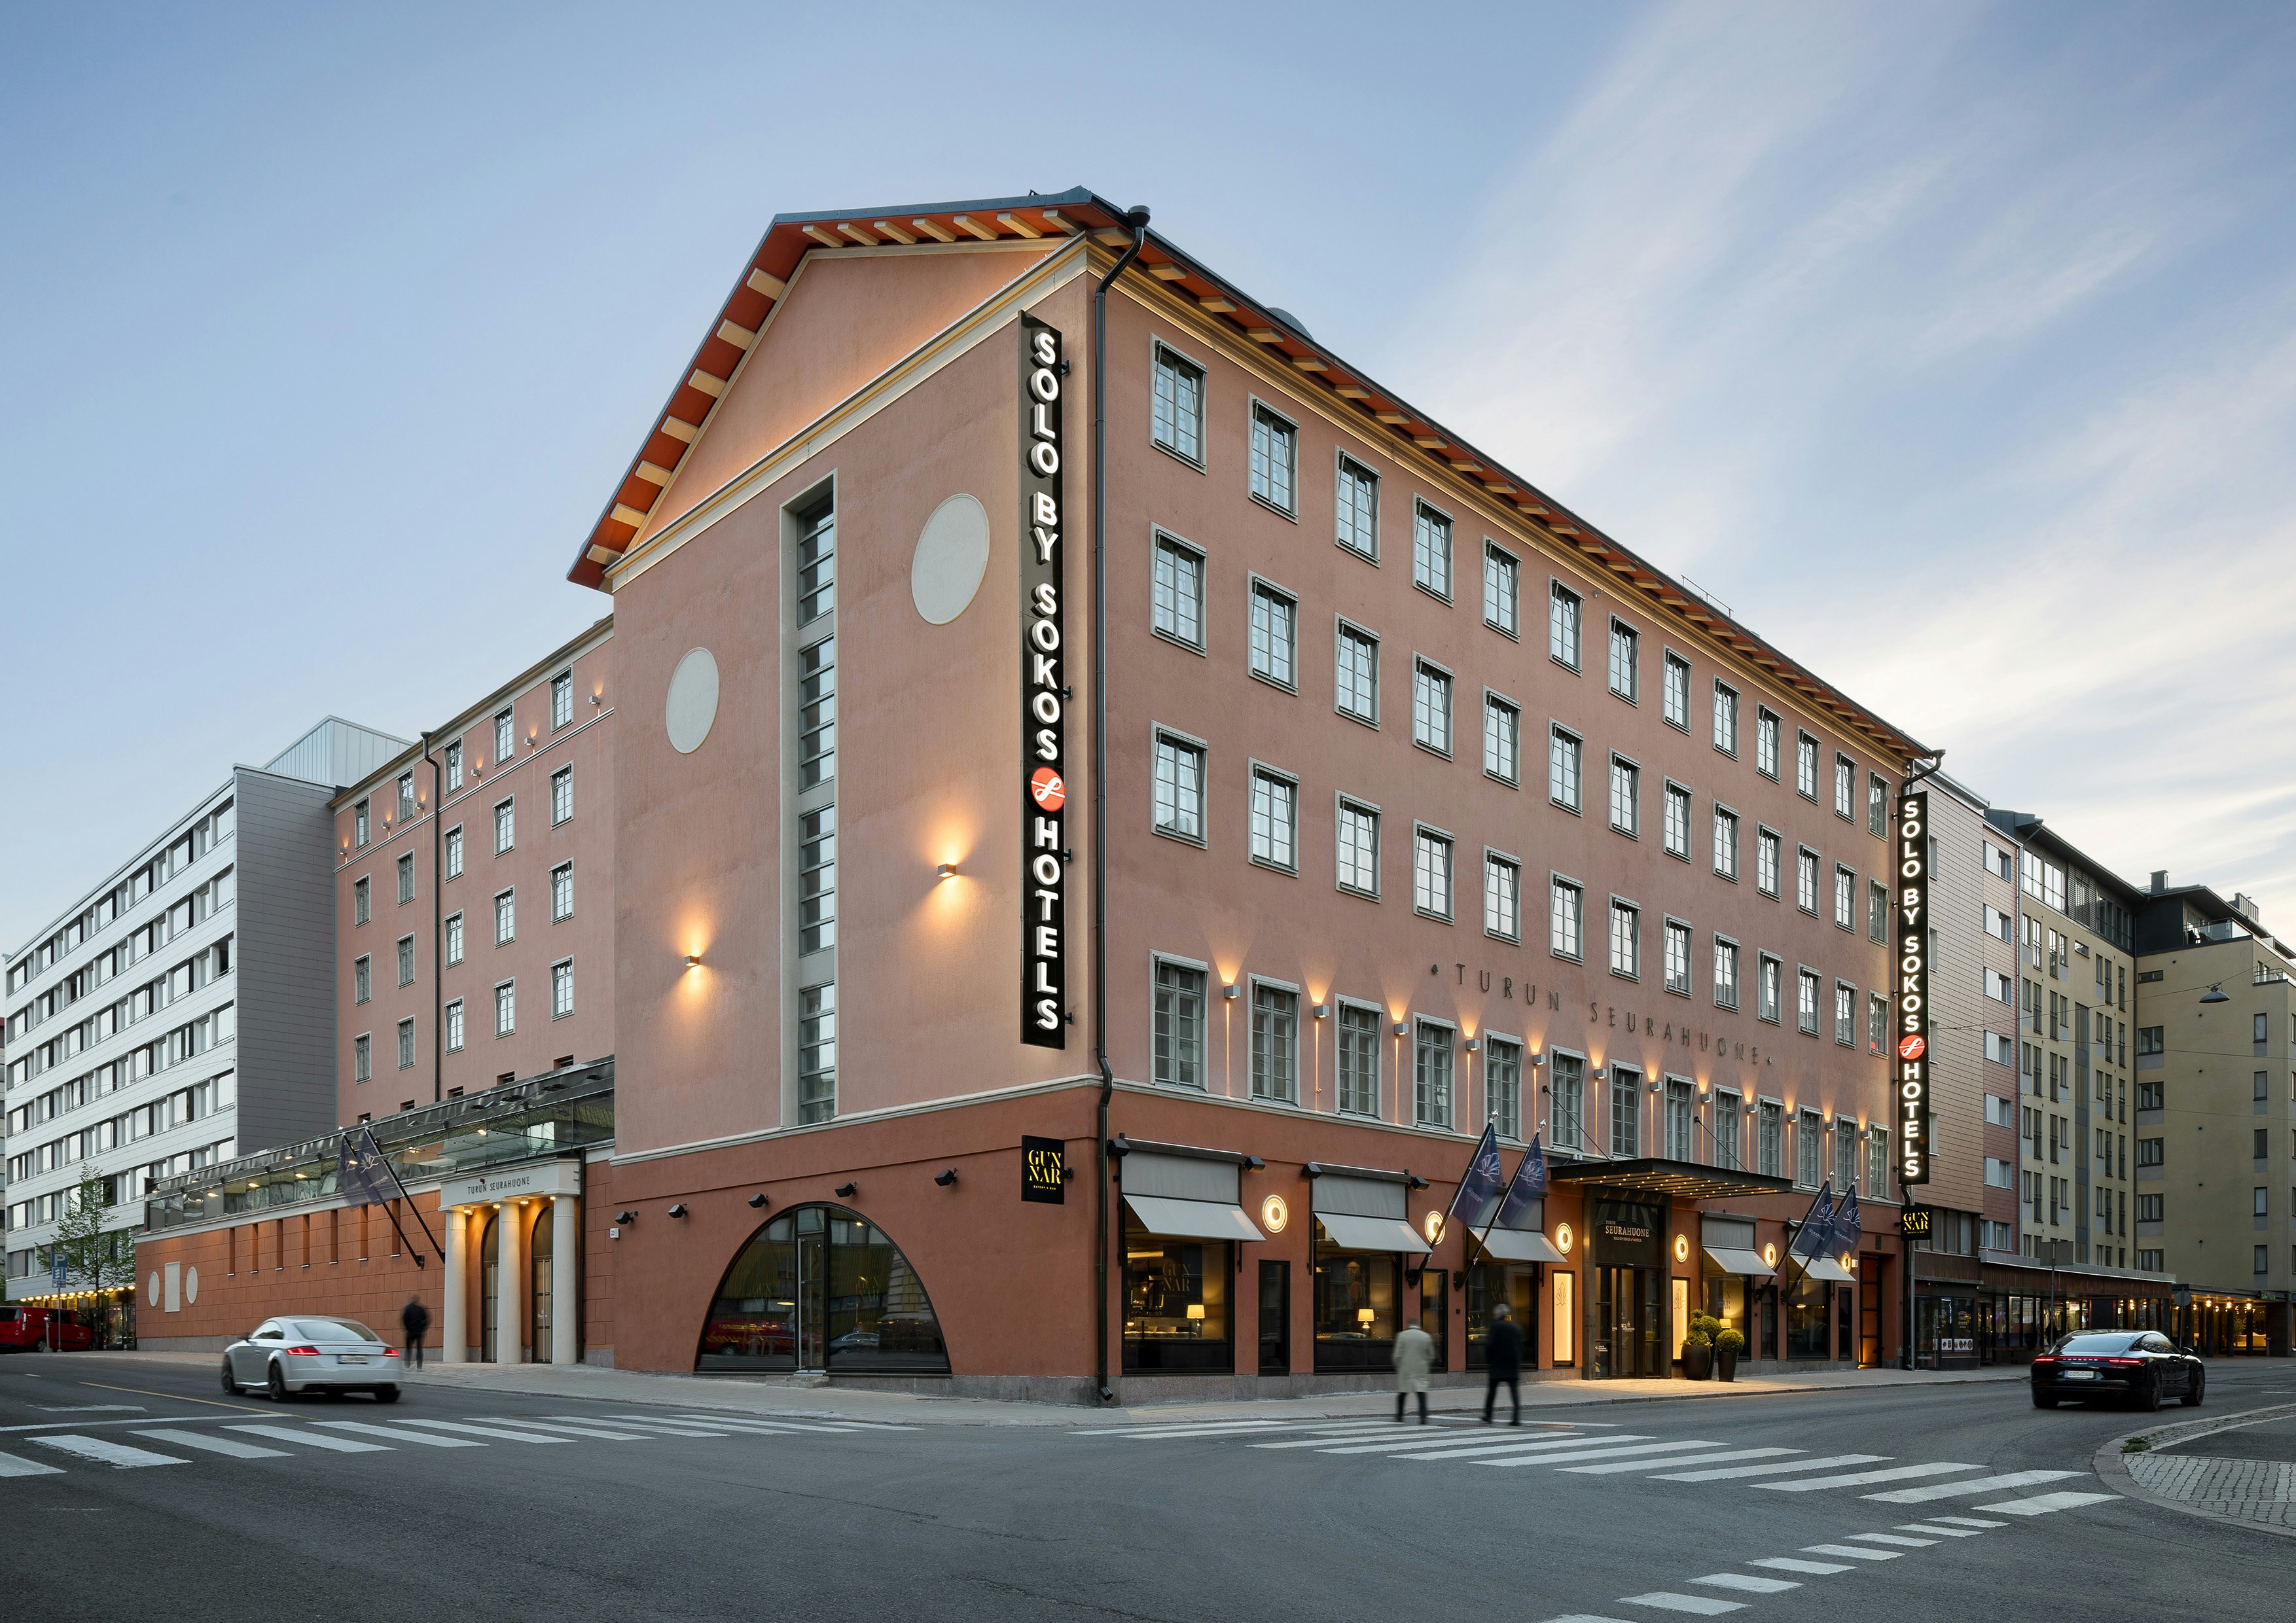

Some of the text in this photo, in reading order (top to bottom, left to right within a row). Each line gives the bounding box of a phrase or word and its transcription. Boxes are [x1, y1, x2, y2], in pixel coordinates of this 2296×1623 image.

[1031, 332, 1060, 1031] SOLO BY SOKOS HOTELS
[1901, 800, 1922, 1177] SOLO BY SOKOS HOTELS
[1456, 963, 1759, 1064] TURUN SEURAHUONE
[1028, 1149, 1062, 1168] GUN
[1029, 1165, 1061, 1184] NAR
[468, 1176, 530, 1194] TURUN SEURAHUONE
[1903, 1211, 1929, 1222] GUN
[1904, 1221, 1928, 1230] NAR
[1605, 1226, 1649, 1237] SEURAHUONE
[54, 1253, 65, 1266] P
[1163, 1277, 1190, 1291] NAR
